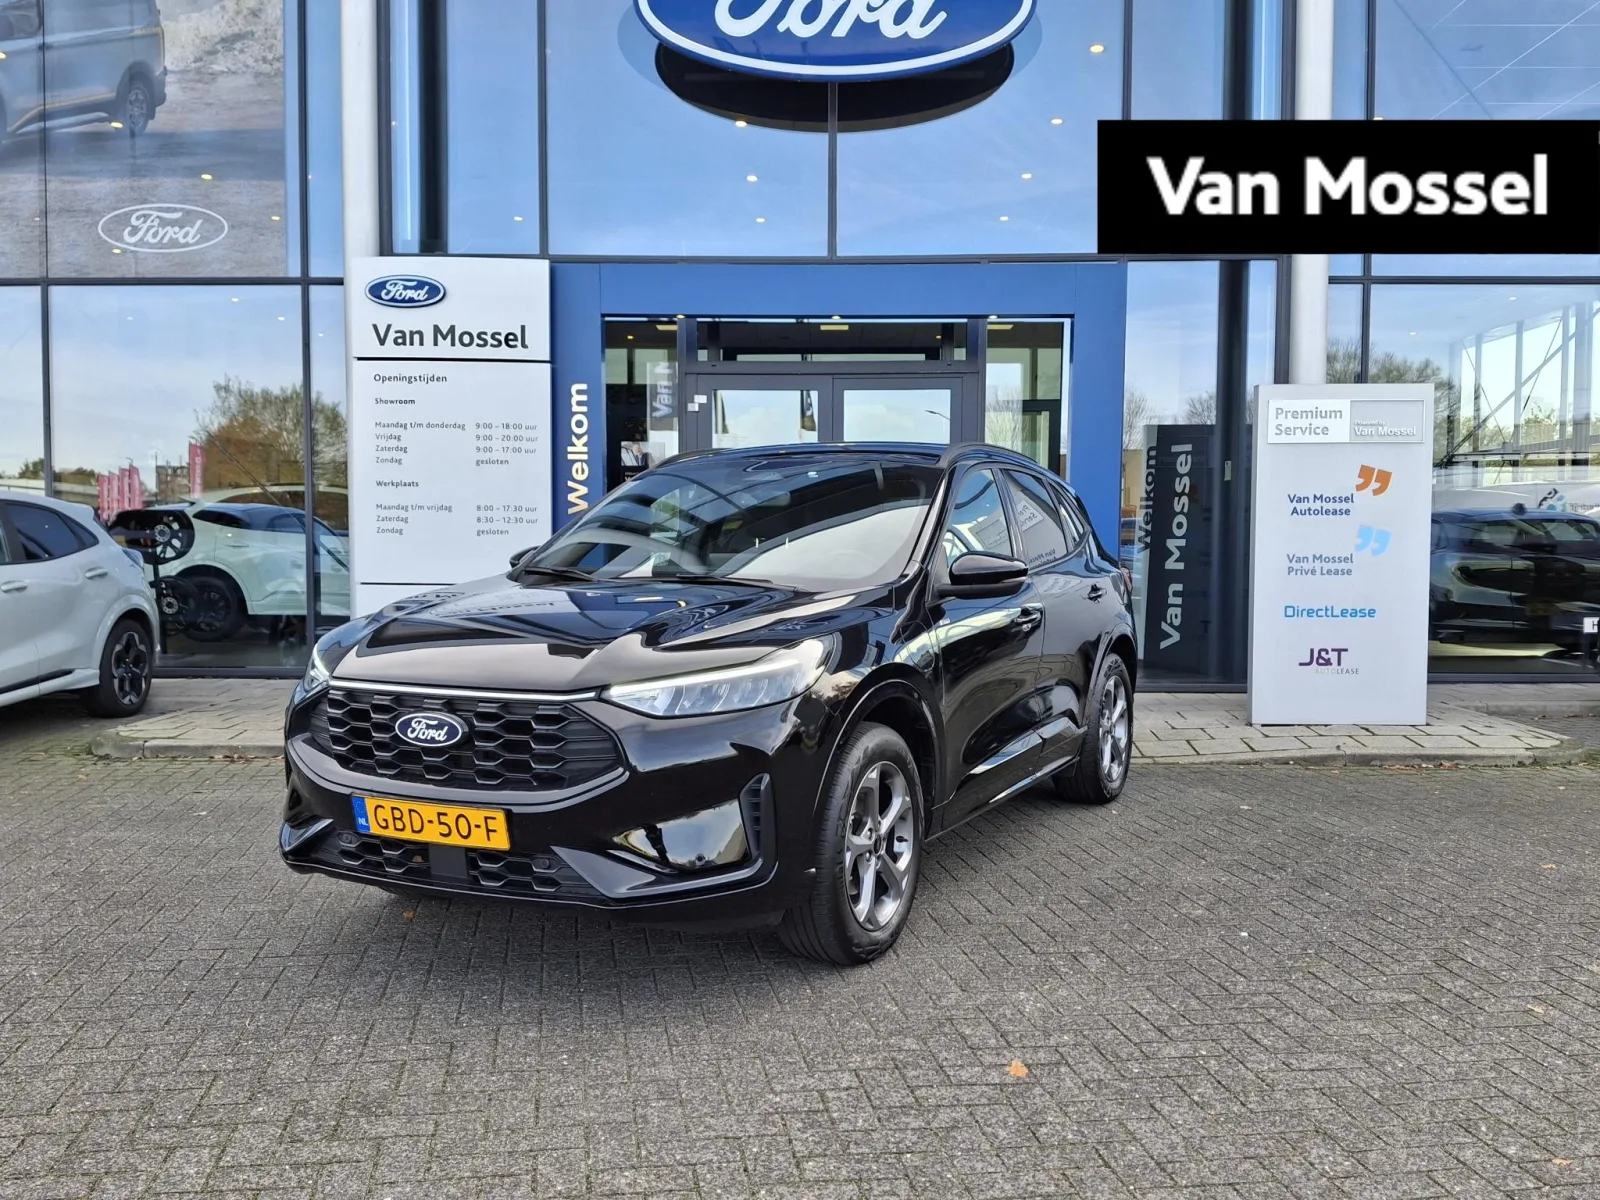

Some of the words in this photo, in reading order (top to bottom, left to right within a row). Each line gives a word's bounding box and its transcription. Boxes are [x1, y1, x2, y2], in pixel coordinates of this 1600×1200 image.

[123, 210, 203, 243] Ford
[380, 279, 429, 301] Ford
[372, 323, 424, 346] Van
[433, 324, 528, 349] Mossel
[373, 374, 447, 384] Openingstijden
[375, 397, 415, 405] Showroom
[651, 380, 672, 418] Van
[1275, 406, 1342, 420] Premium
[375, 422, 407, 430] Maandag
[426, 422, 465, 431] donderdag
[476, 422, 493, 430] 9:00
[1275, 424, 1329, 436] Service
[1354, 426, 1375, 436] Van
[1378, 426, 1416, 436] Mossel
[375, 433, 402, 442] Vrijdag
[375, 445, 408, 453] Zaterdag
[502, 446, 522, 454] 17:00
[567, 383, 588, 514] Welkom
[376, 457, 403, 465] Zondag
[476, 458, 509, 466] gesloten
[376, 480, 419, 488] Werkplaats
[1137, 446, 1157, 554] Welkom
[1288, 494, 1309, 504] Van
[1313, 493, 1354, 504] Mossel
[376, 504, 409, 513] Maandag
[427, 504, 452, 513] vrijdag
[1164, 444, 1193, 569] Mossel
[1290, 506, 1351, 516] Autolease
[376, 515, 409, 524] Zaterdag
[376, 527, 404, 536] Zondag
[476, 528, 509, 537] gesloten
[1286, 554, 1309, 564] Van
[1312, 553, 1354, 564] Mossel
[1287, 566, 1317, 576] Privé
[1320, 566, 1353, 576] Lease
[1160, 582, 1184, 649] Van
[1284, 605, 1376, 618] DirectLease
[1298, 648, 1349, 666] J&T
[407, 718, 448, 741] Ford
[358, 817, 369, 826] NL
[374, 804, 498, 841] GBD-50-F
